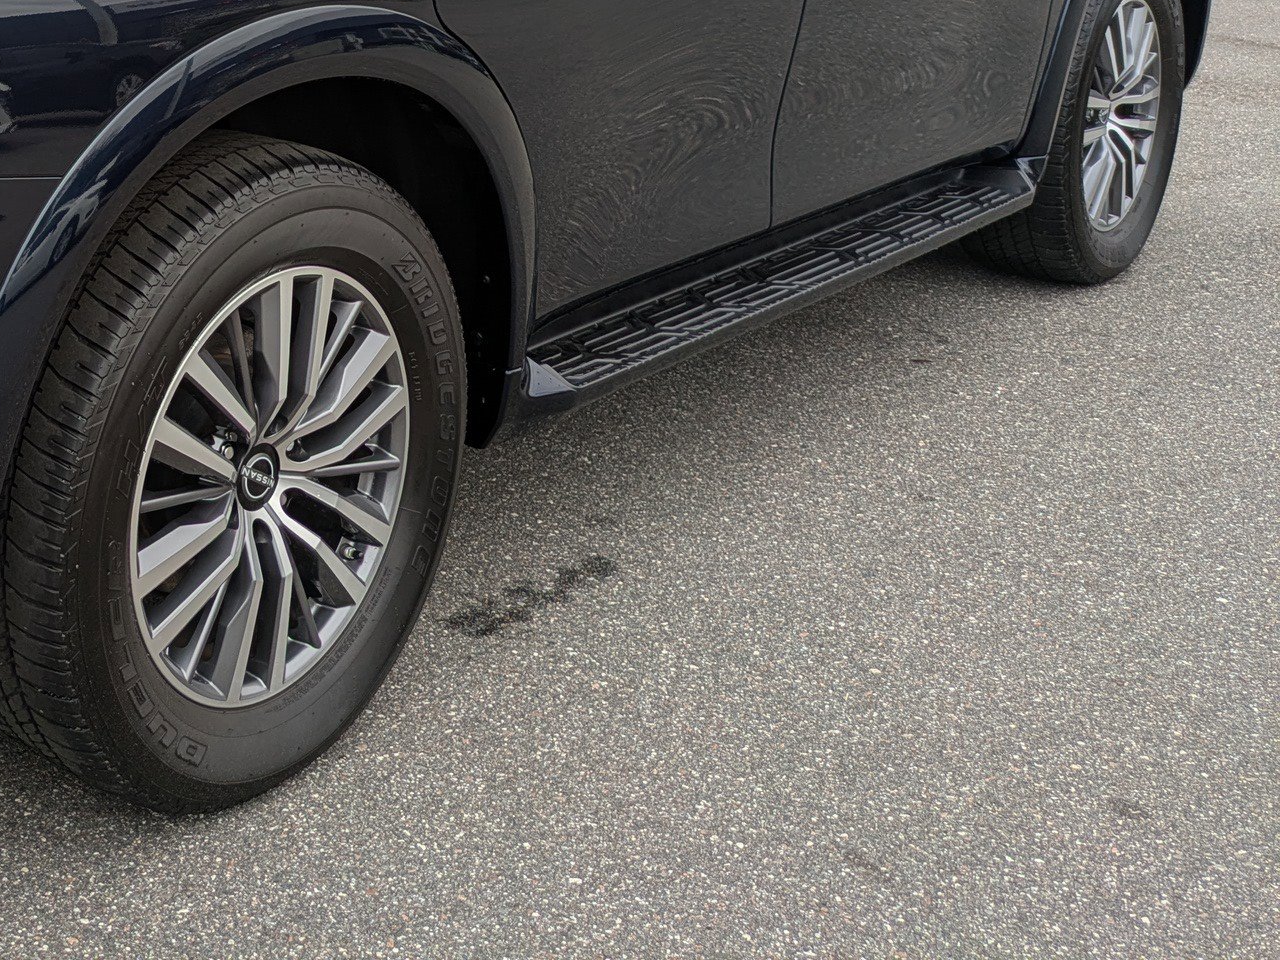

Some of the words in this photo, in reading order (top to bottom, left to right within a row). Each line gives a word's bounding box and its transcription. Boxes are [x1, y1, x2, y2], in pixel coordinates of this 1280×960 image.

[241, 466, 274, 487] NISSAN
[391, 251, 456, 579] BRIDGESTONE
[106, 539, 209, 767] DUELER
